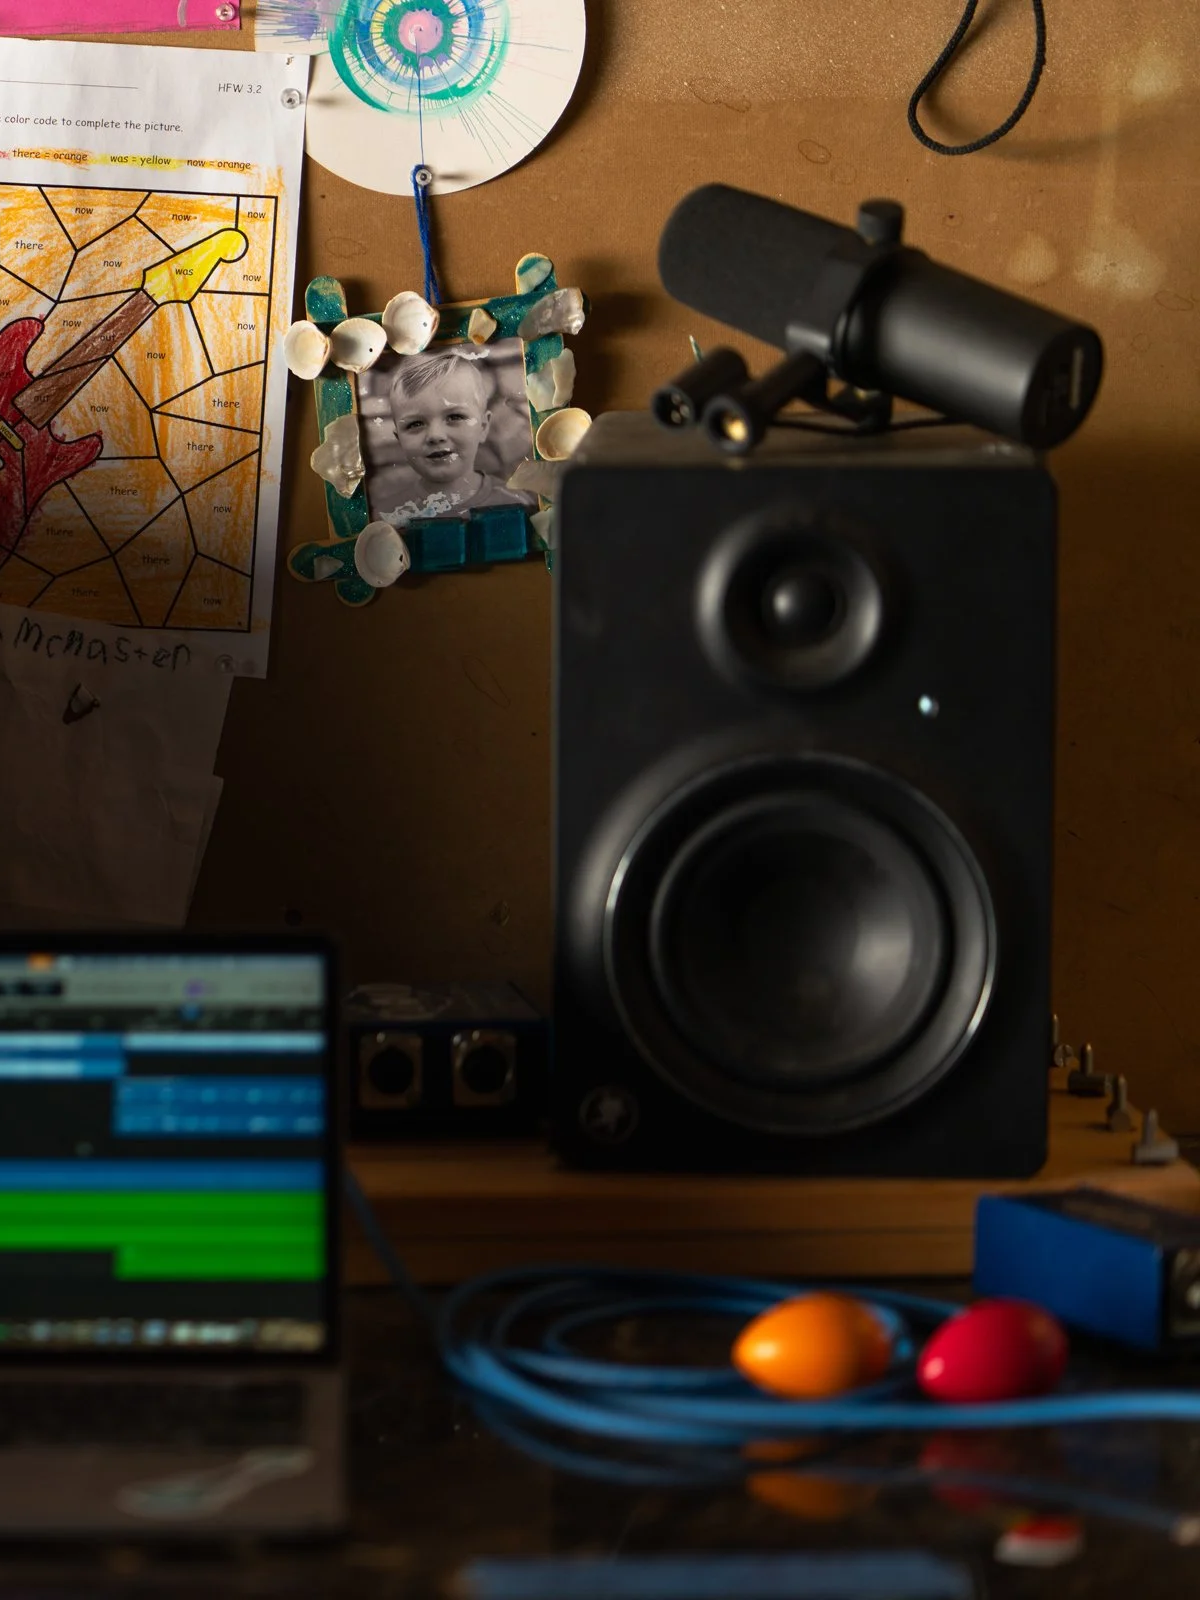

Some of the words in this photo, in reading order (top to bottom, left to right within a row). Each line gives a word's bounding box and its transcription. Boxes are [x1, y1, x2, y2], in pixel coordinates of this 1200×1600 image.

[218, 83, 243, 93] HFW
[246, 84, 262, 94] 3.2
[4, 114, 31, 125] color
[33, 115, 58, 126] code
[61, 117, 72, 127] to
[75, 118, 121, 131] complete
[124, 120, 141, 130] the
[144, 121, 184, 133] picture.
[12, 149, 41, 159] there
[53, 152, 88, 162] orange
[110, 155, 129, 163] was
[140, 155, 172, 166] yellow
[186, 158, 206, 167] now
[217, 161, 251, 171] orange
[74, 206, 94, 215] now
[247, 210, 266, 219] now
[171, 213, 191, 222] now
[14, 240, 44, 251] there
[103, 259, 123, 268] now
[174, 267, 194, 276] was
[242, 273, 262, 282] now
[62, 319, 82, 328] now
[237, 321, 256, 331] now
[146, 350, 166, 360] now
[90, 403, 110, 413] now
[212, 398, 241, 409] there
[0, 424, 14, 439] was
[186, 441, 215, 452] there
[110, 485, 138, 497] there
[213, 504, 232, 514] now
[46, 527, 74, 538] there
[141, 554, 171, 566] there
[71, 587, 100, 598] there
[203, 597, 222, 606] now
